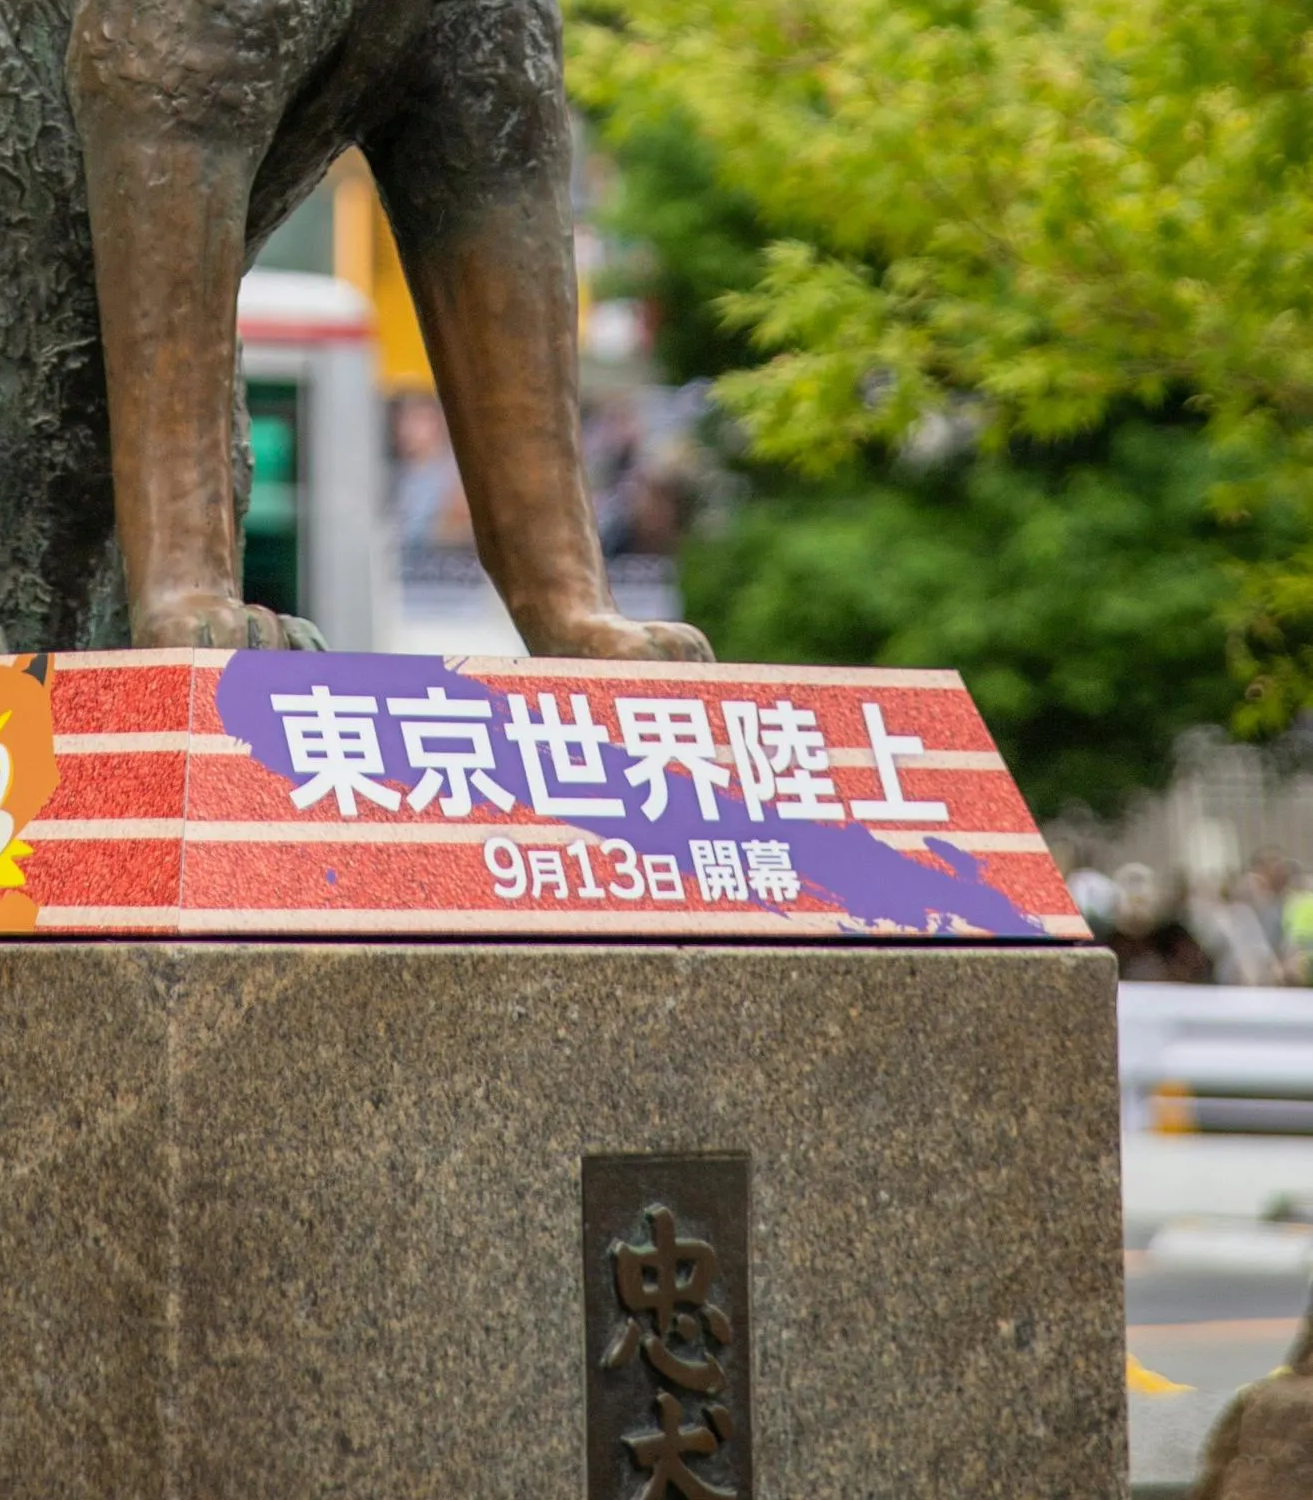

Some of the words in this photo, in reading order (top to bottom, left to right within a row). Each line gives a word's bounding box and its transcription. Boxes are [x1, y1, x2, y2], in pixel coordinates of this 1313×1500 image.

[270, 686, 948, 822] 東京世界陸上
[600, 1202, 737, 1500] 忠犬
